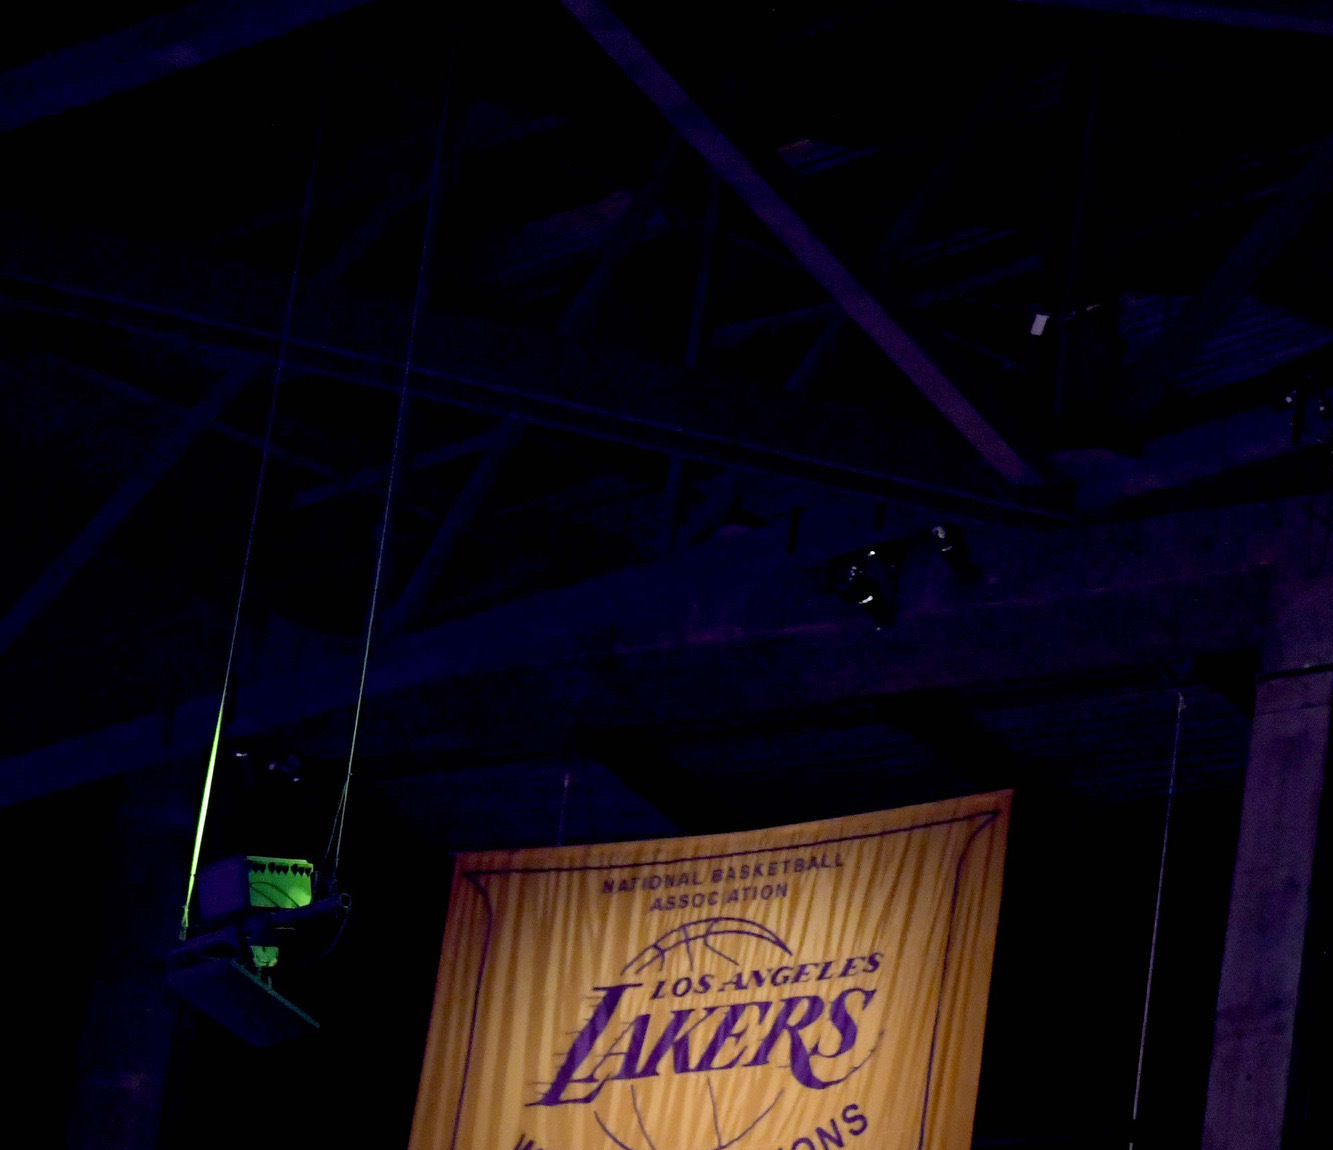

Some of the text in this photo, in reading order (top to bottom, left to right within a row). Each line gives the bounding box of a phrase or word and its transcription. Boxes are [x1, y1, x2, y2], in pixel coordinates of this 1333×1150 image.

[603, 851, 844, 895] NATIONAL BASKETBALL
[650, 883, 788, 912] ASSOCATION
[652, 952, 883, 999] LOS ANGELES
[525, 983, 877, 1107] LAKERS
